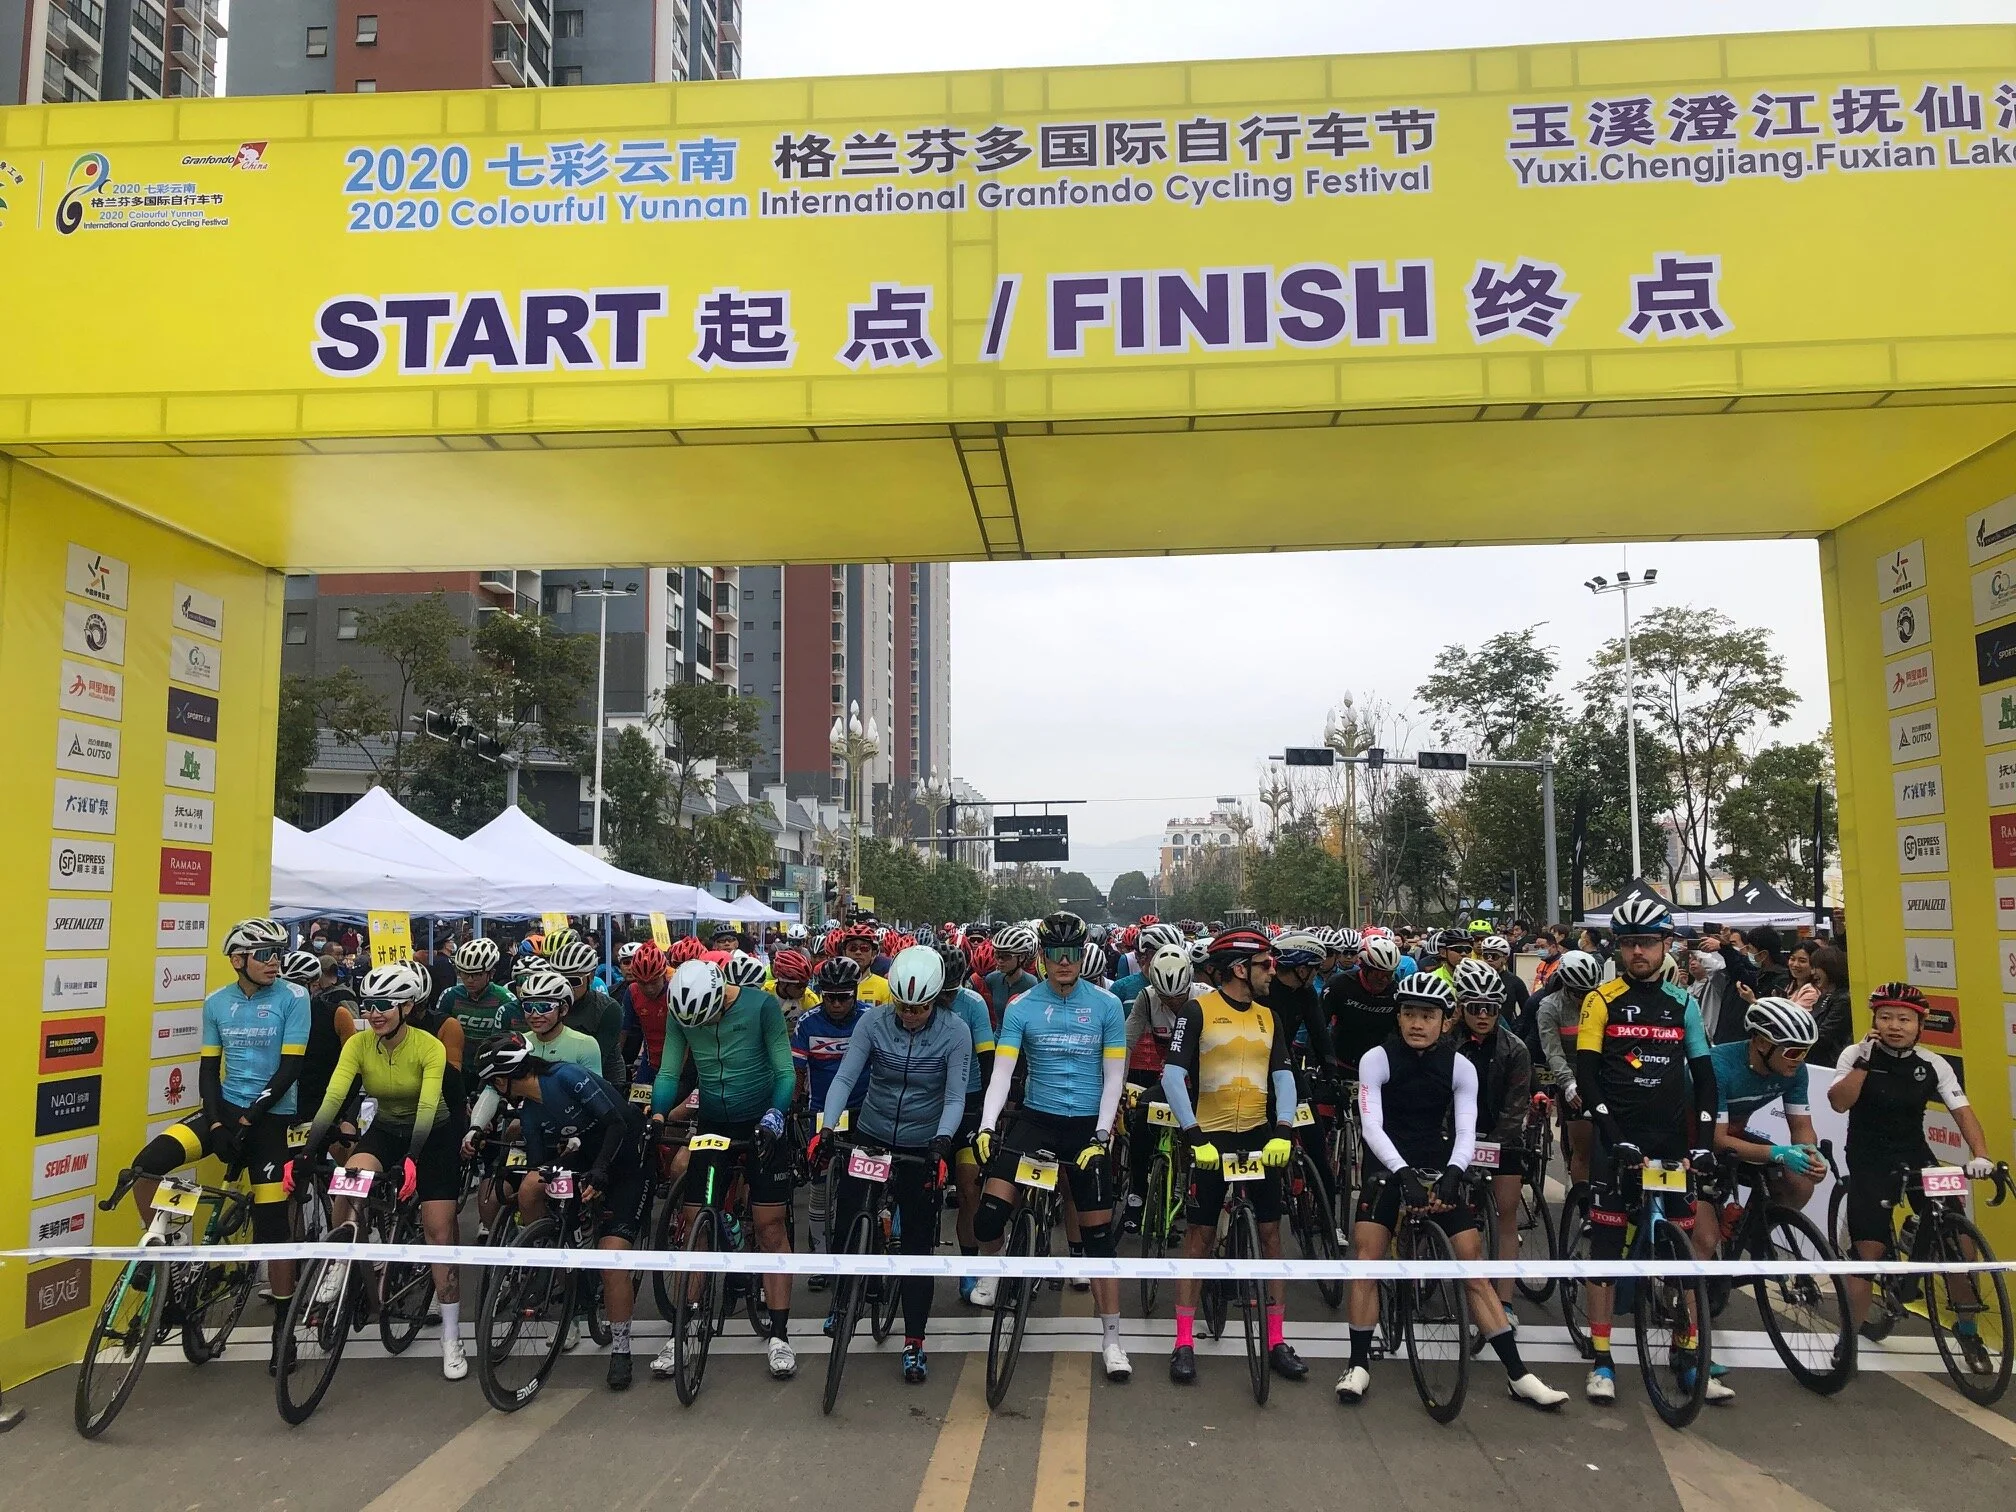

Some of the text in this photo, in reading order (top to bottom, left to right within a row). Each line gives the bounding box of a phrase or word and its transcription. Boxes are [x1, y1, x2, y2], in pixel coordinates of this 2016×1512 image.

[346, 111, 1435, 191] 2020 七彩云南 格兰芬多国际自行车节
[182, 156, 235, 165] Granfondo
[241, 161, 268, 170] China
[1513, 138, 2016, 183] Yuxi.Chengjiang.Fuxian Lak
[113, 183, 196, 194] 2020 七彩云南
[90, 194, 224, 208] 格兰芬多国际自行车节
[350, 165, 1429, 229] 2020 Colourful Yunnan International Granfondo Cycling Festival
[100, 210, 204, 220] 2020 Colourful Yunnan
[83, 218, 228, 229] International Granfondo Cycling Festival
[317, 293, 661, 371] START
[986, 281, 1014, 354] /
[1053, 264, 1429, 351] FINISH
[187, 711, 204, 722] SPORTS
[1912, 732, 1932, 745] OUTSO
[86, 748, 111, 760] OUTSO
[175, 805, 203, 819] 抚仙湖
[1917, 836, 1940, 846] EXPRESS
[62, 853, 105, 869] SF EXPRESS
[170, 857, 202, 871] RAMADA
[1907, 899, 1946, 911] SPECIALIZED
[53, 917, 105, 931] SPECIALIZED
[378, 945, 407, 964] 计时区
[173, 973, 201, 982] JAKROO
[1345, 998, 1394, 1014] SPECIALIZED
[1617, 1026, 1679, 1039] PACO TORA
[51, 1092, 76, 1108] NAQI
[632, 1089, 651, 1100] 205
[695, 1139, 724, 1148] 115
[45, 1154, 89, 1178] SEVEN MIN
[854, 1161, 885, 1177] 502
[1228, 1161, 1260, 1175] 154
[1030, 1168, 1041, 1181] 5
[1659, 1172, 1667, 1184] 1
[334, 1177, 366, 1192] 501
[546, 1181, 568, 1193] 03
[1928, 1176, 1962, 1190] 546
[168, 1193, 183, 1206] 4
[1597, 1213, 1622, 1224] TORA
[38, 1218, 71, 1241] 美骑网
